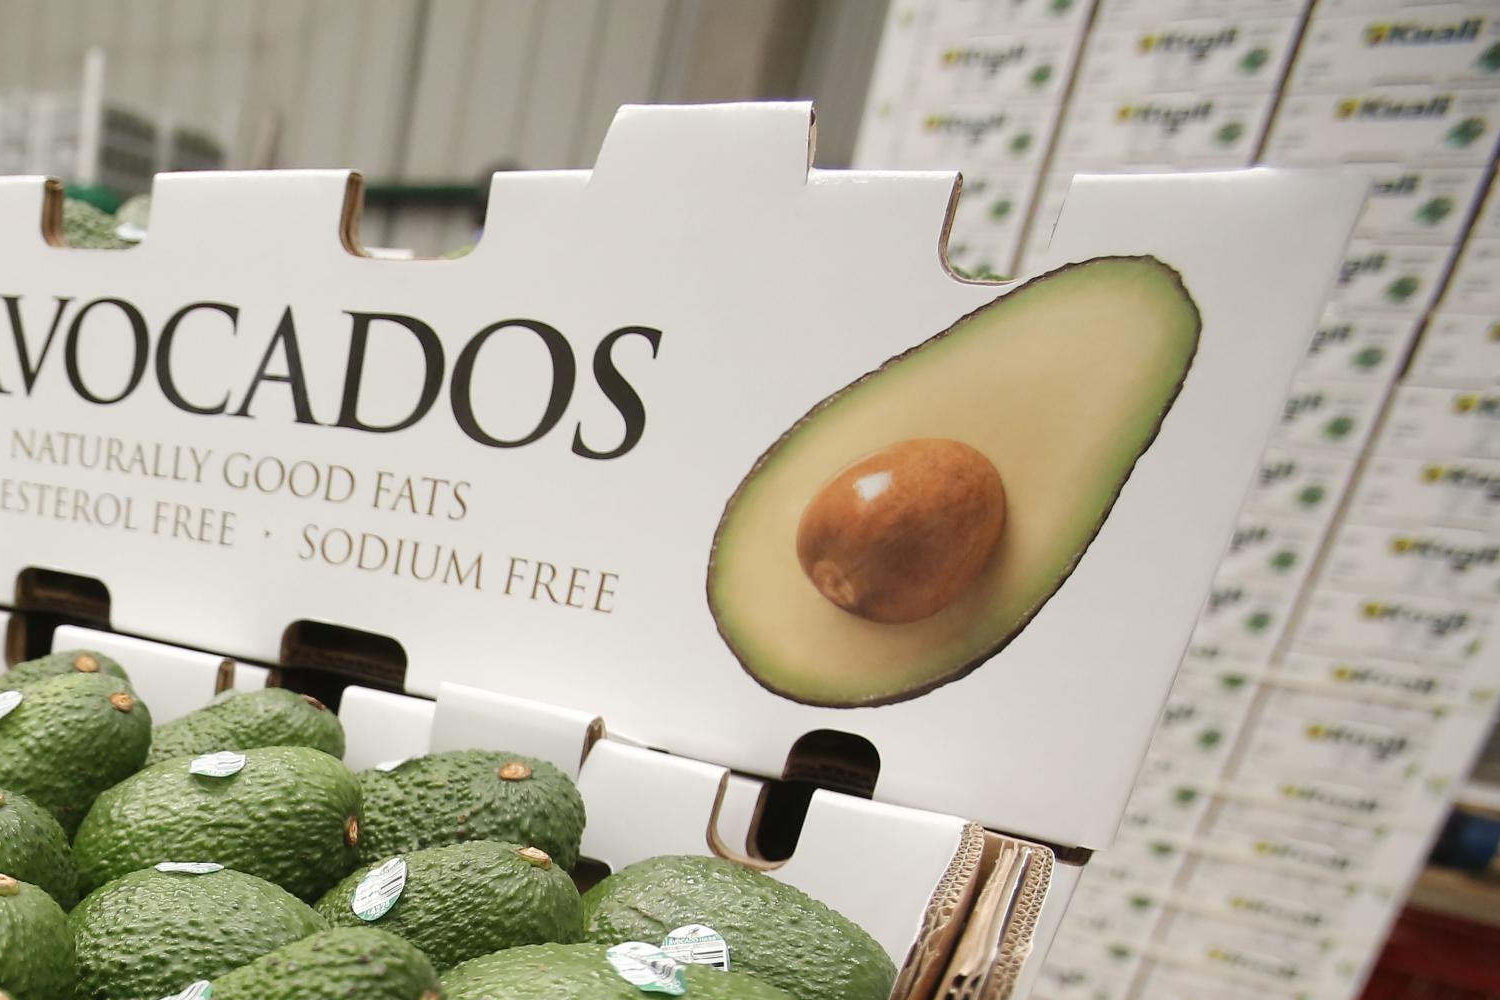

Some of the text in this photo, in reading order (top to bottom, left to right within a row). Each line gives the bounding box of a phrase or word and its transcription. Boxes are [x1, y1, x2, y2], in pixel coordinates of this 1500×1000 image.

[10, 428, 472, 521] NATURALLY GOOD FATS
[151, 500, 238, 547] FREE
[299, 524, 484, 592] SODIUM
[503, 557, 620, 614] FREE
